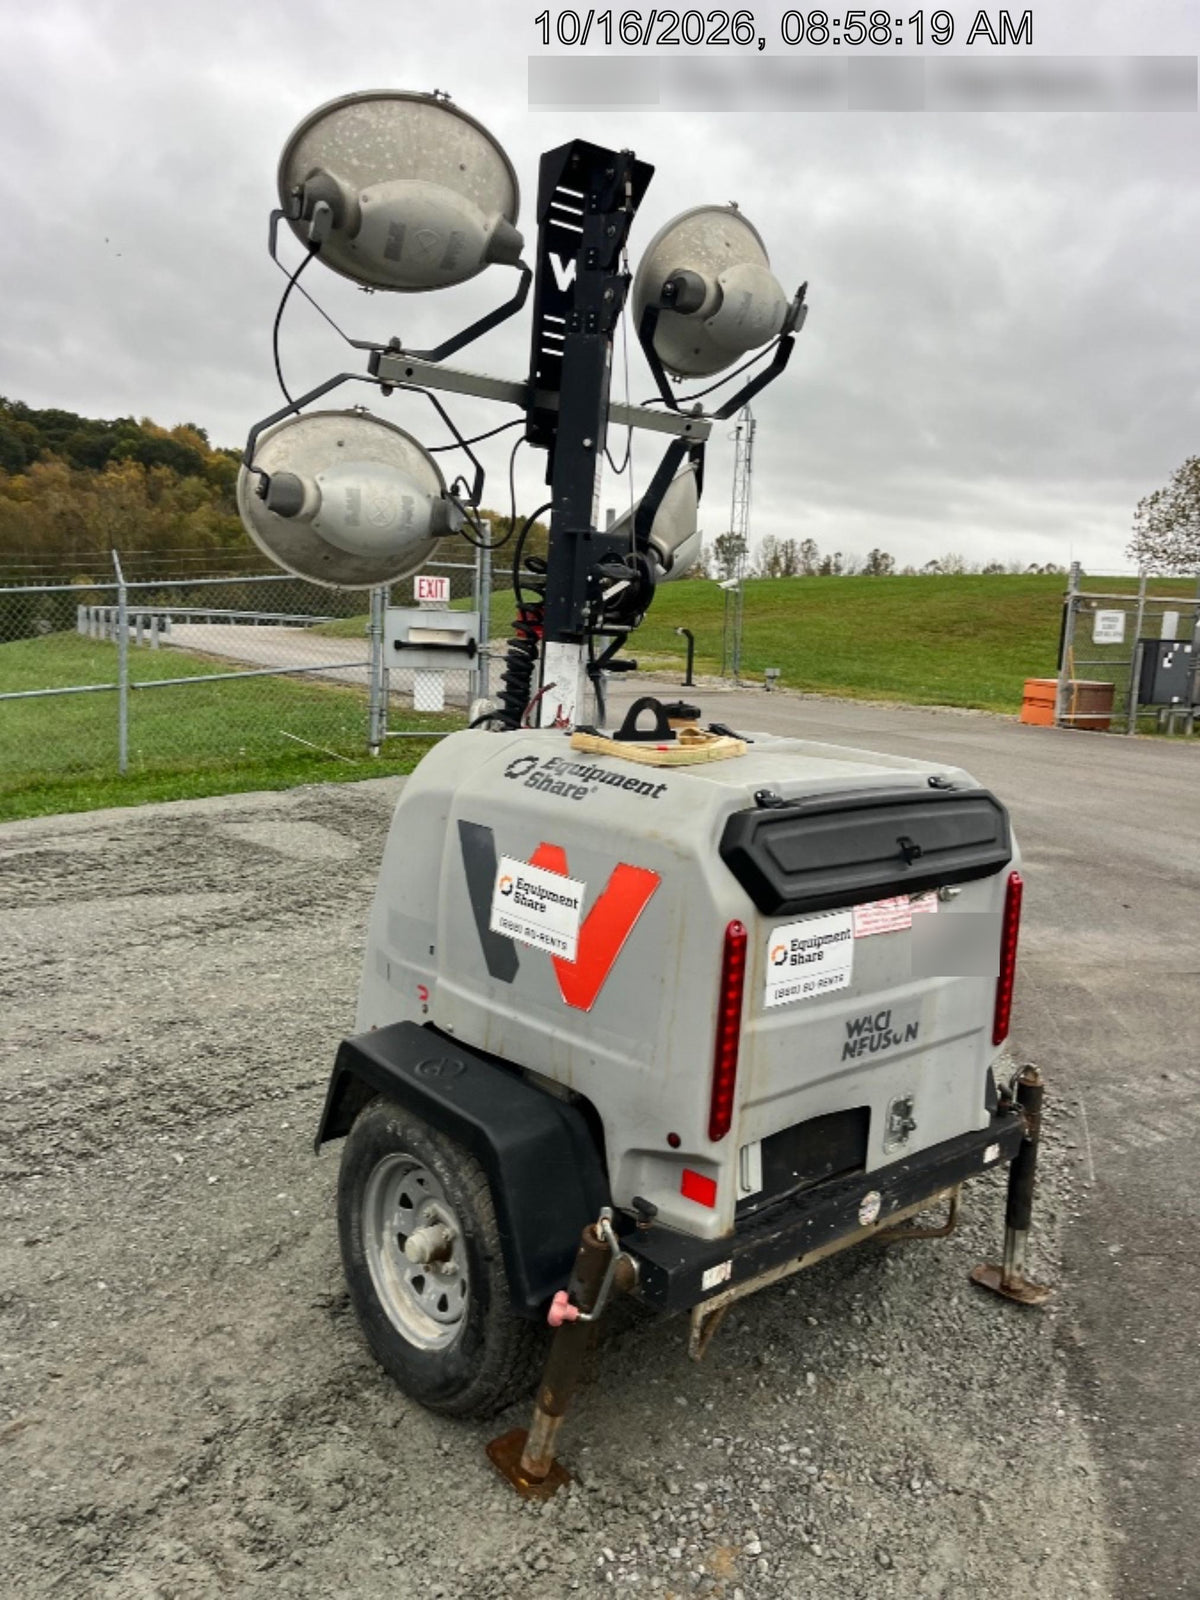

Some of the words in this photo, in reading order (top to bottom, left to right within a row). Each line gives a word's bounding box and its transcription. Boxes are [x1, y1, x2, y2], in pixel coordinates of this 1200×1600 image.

[419, 579, 445, 598] EXIT
[541, 756, 668, 800] Equipment
[513, 891, 546, 913] Share
[515, 877, 579, 909] Equipment
[790, 929, 851, 952] Equipment
[789, 950, 824, 966] Share
